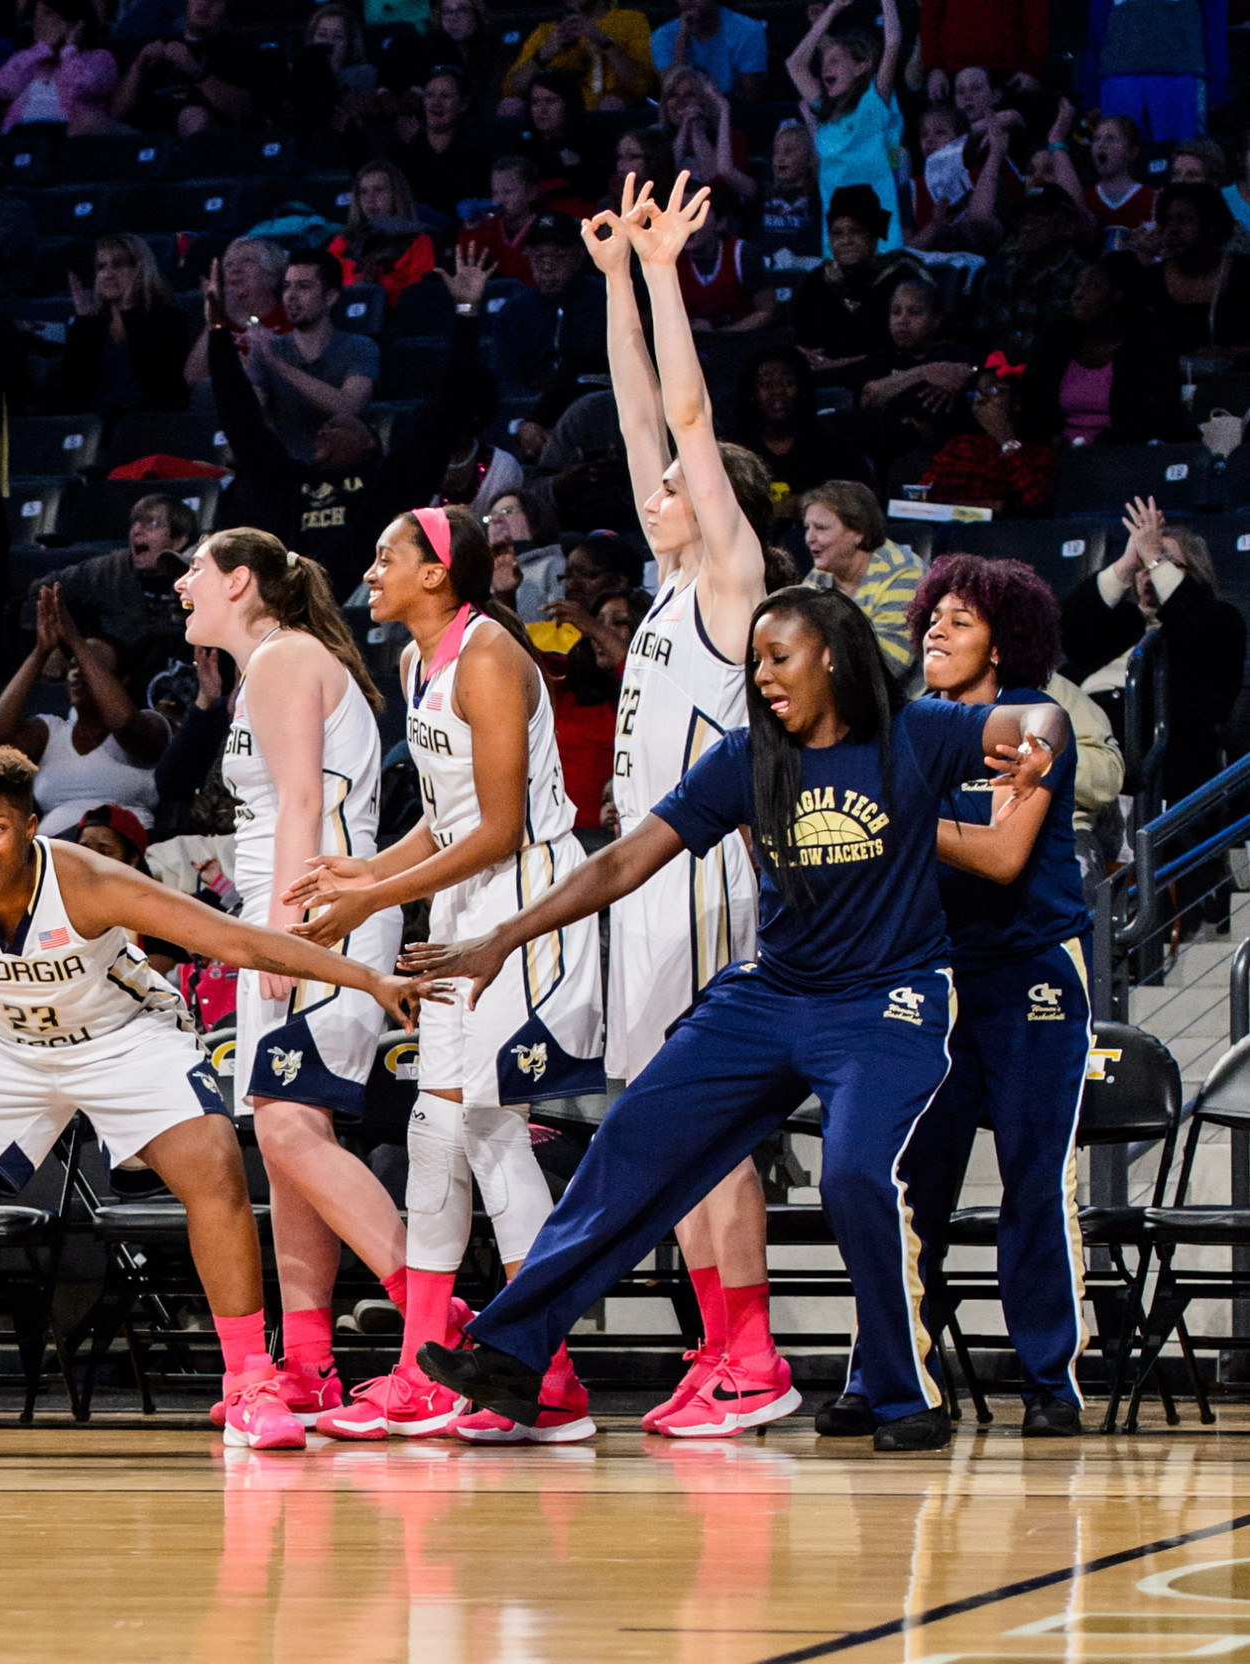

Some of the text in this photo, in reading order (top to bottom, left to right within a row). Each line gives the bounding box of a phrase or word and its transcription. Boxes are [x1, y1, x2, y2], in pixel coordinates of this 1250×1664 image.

[301, 506, 347, 532] TECH
[841, 789, 890, 835] TECH
[826, 838, 884, 864] JACKETS
[3, 1003, 59, 1032] 23
